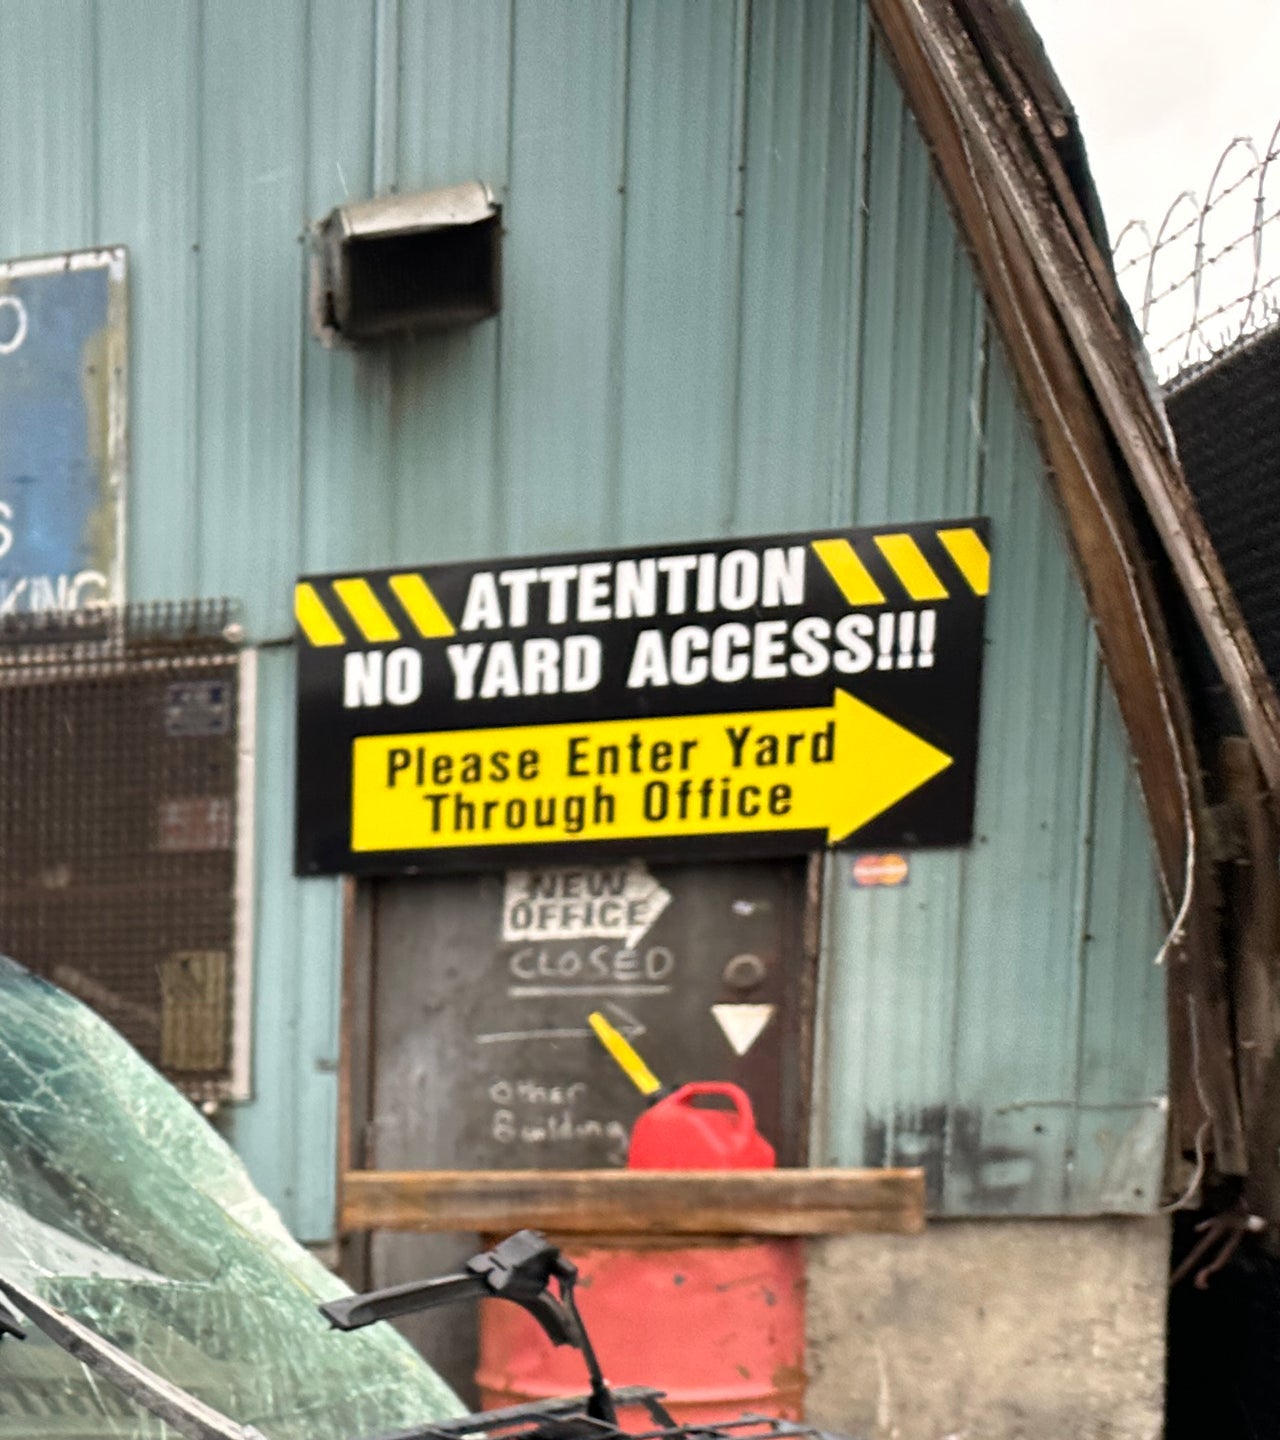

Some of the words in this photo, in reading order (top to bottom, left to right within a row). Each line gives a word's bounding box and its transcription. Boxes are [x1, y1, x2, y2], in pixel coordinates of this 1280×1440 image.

[461, 546, 806, 632] ATTENTION
[343, 647, 422, 708] NO
[447, 633, 602, 700] YARD
[626, 610, 937, 690] ACCESS!!!
[386, 739, 541, 788] Please
[567, 733, 699, 780] Enter
[724, 721, 836, 768] Yard
[424, 786, 615, 834] Through
[643, 779, 793, 822] Office
[529, 870, 627, 898] NEW
[510, 900, 649, 930] OFFICE
[509, 945, 675, 981] CLOSED
